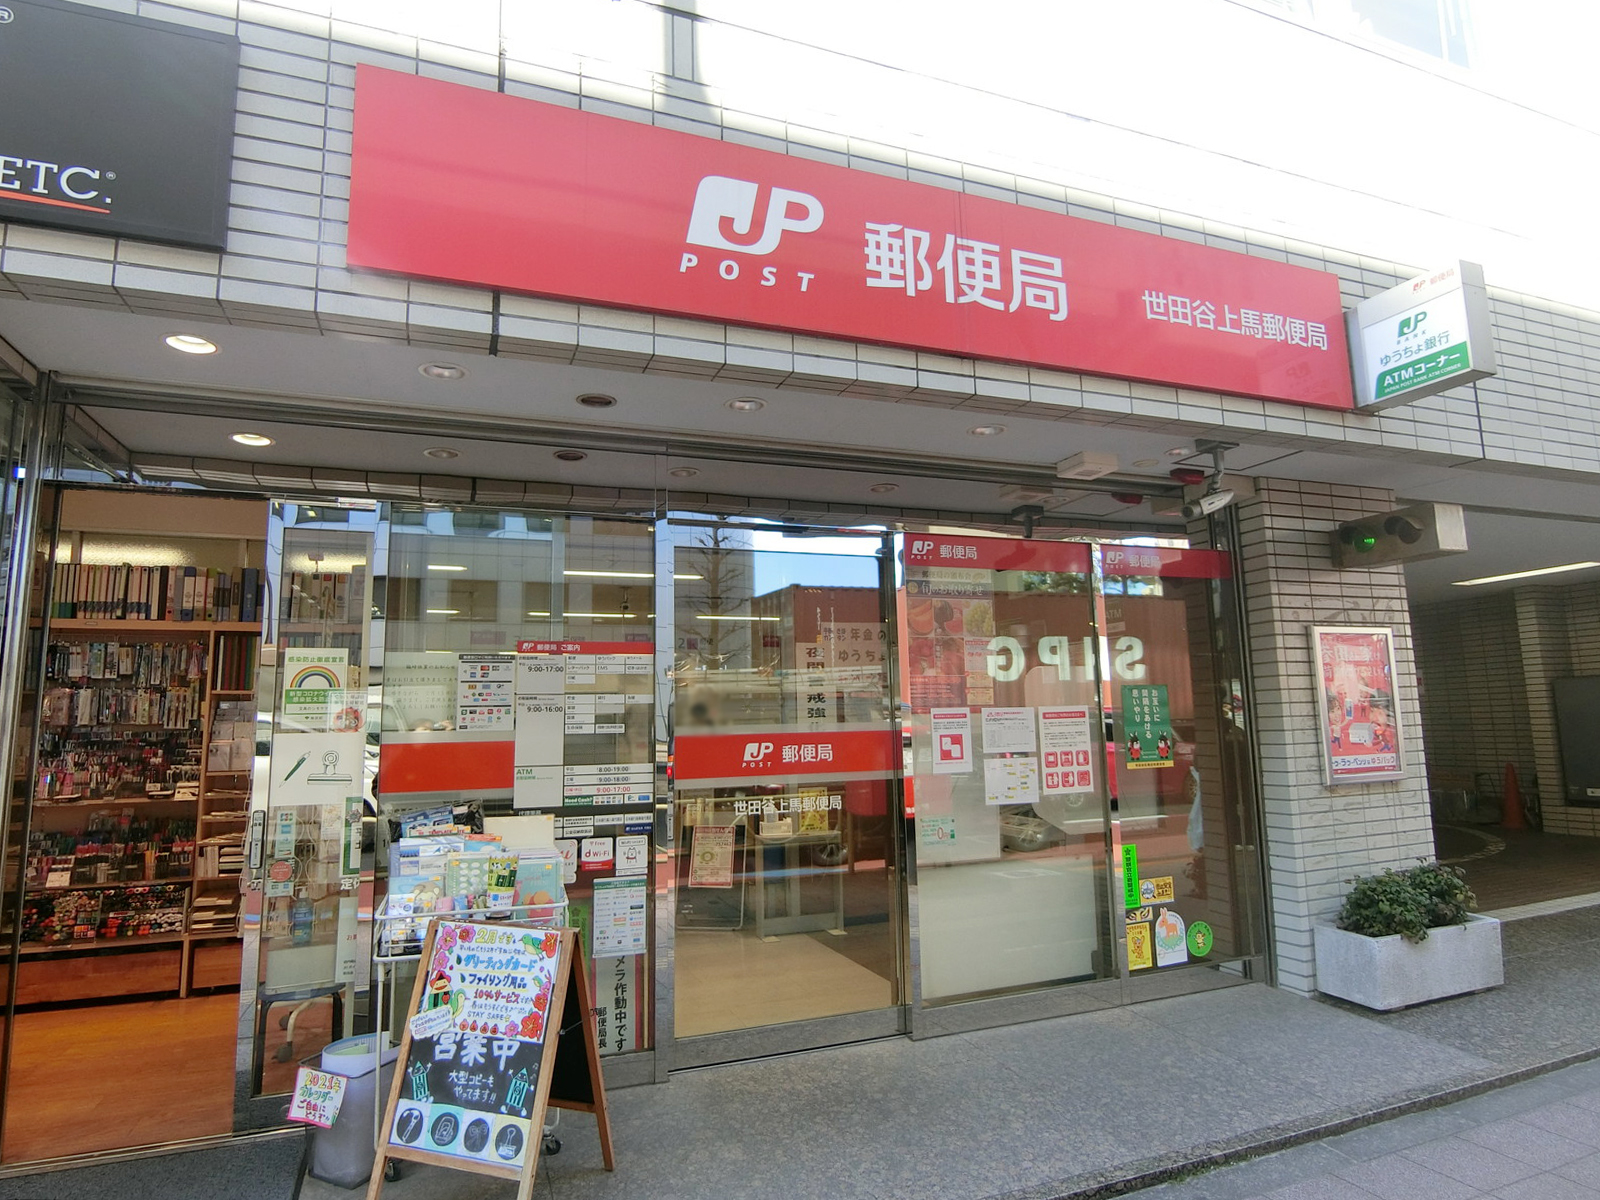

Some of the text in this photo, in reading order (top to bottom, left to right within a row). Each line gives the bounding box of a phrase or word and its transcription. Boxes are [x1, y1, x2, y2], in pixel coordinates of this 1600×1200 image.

[686, 175, 824, 255] JP
[679, 252, 815, 292] POST
[864, 221, 1068, 321] 郵便局
[1141, 289, 1328, 351] 世田谷上馬郵便局
[1398, 311, 1428, 338] JP
[1396, 329, 1427, 345] BANK
[1380, 330, 1450, 367] ゆうちょ銀行
[1383, 353, 1461, 387] ATMコーナー
[1400, 379, 1413, 388] POST
[939, 544, 978, 560] 郵便局
[1128, 554, 1161, 569] 郵便局
[560, 643, 581, 652] ご案内
[527, 665, 564, 673] 9:00-17:00
[743, 742, 774, 761] JP
[781, 744, 833, 763] 郵便局
[733, 795, 842, 816] 世田谷上馬郵便局
[463, 953, 538, 972] グリーティングカード
[468, 973, 528, 989] ファイリング用品
[467, 1011, 505, 1021] STAY SAFE
[597, 1006, 608, 1049] 郵便局長
[432, 1032, 521, 1071] 営業中
[305, 1071, 341, 1093] 2021年
[448, 1069, 495, 1087] 大型コピーも
[299, 1085, 333, 1103] カレンダー
[297, 1098, 326, 1113] ご自由に
